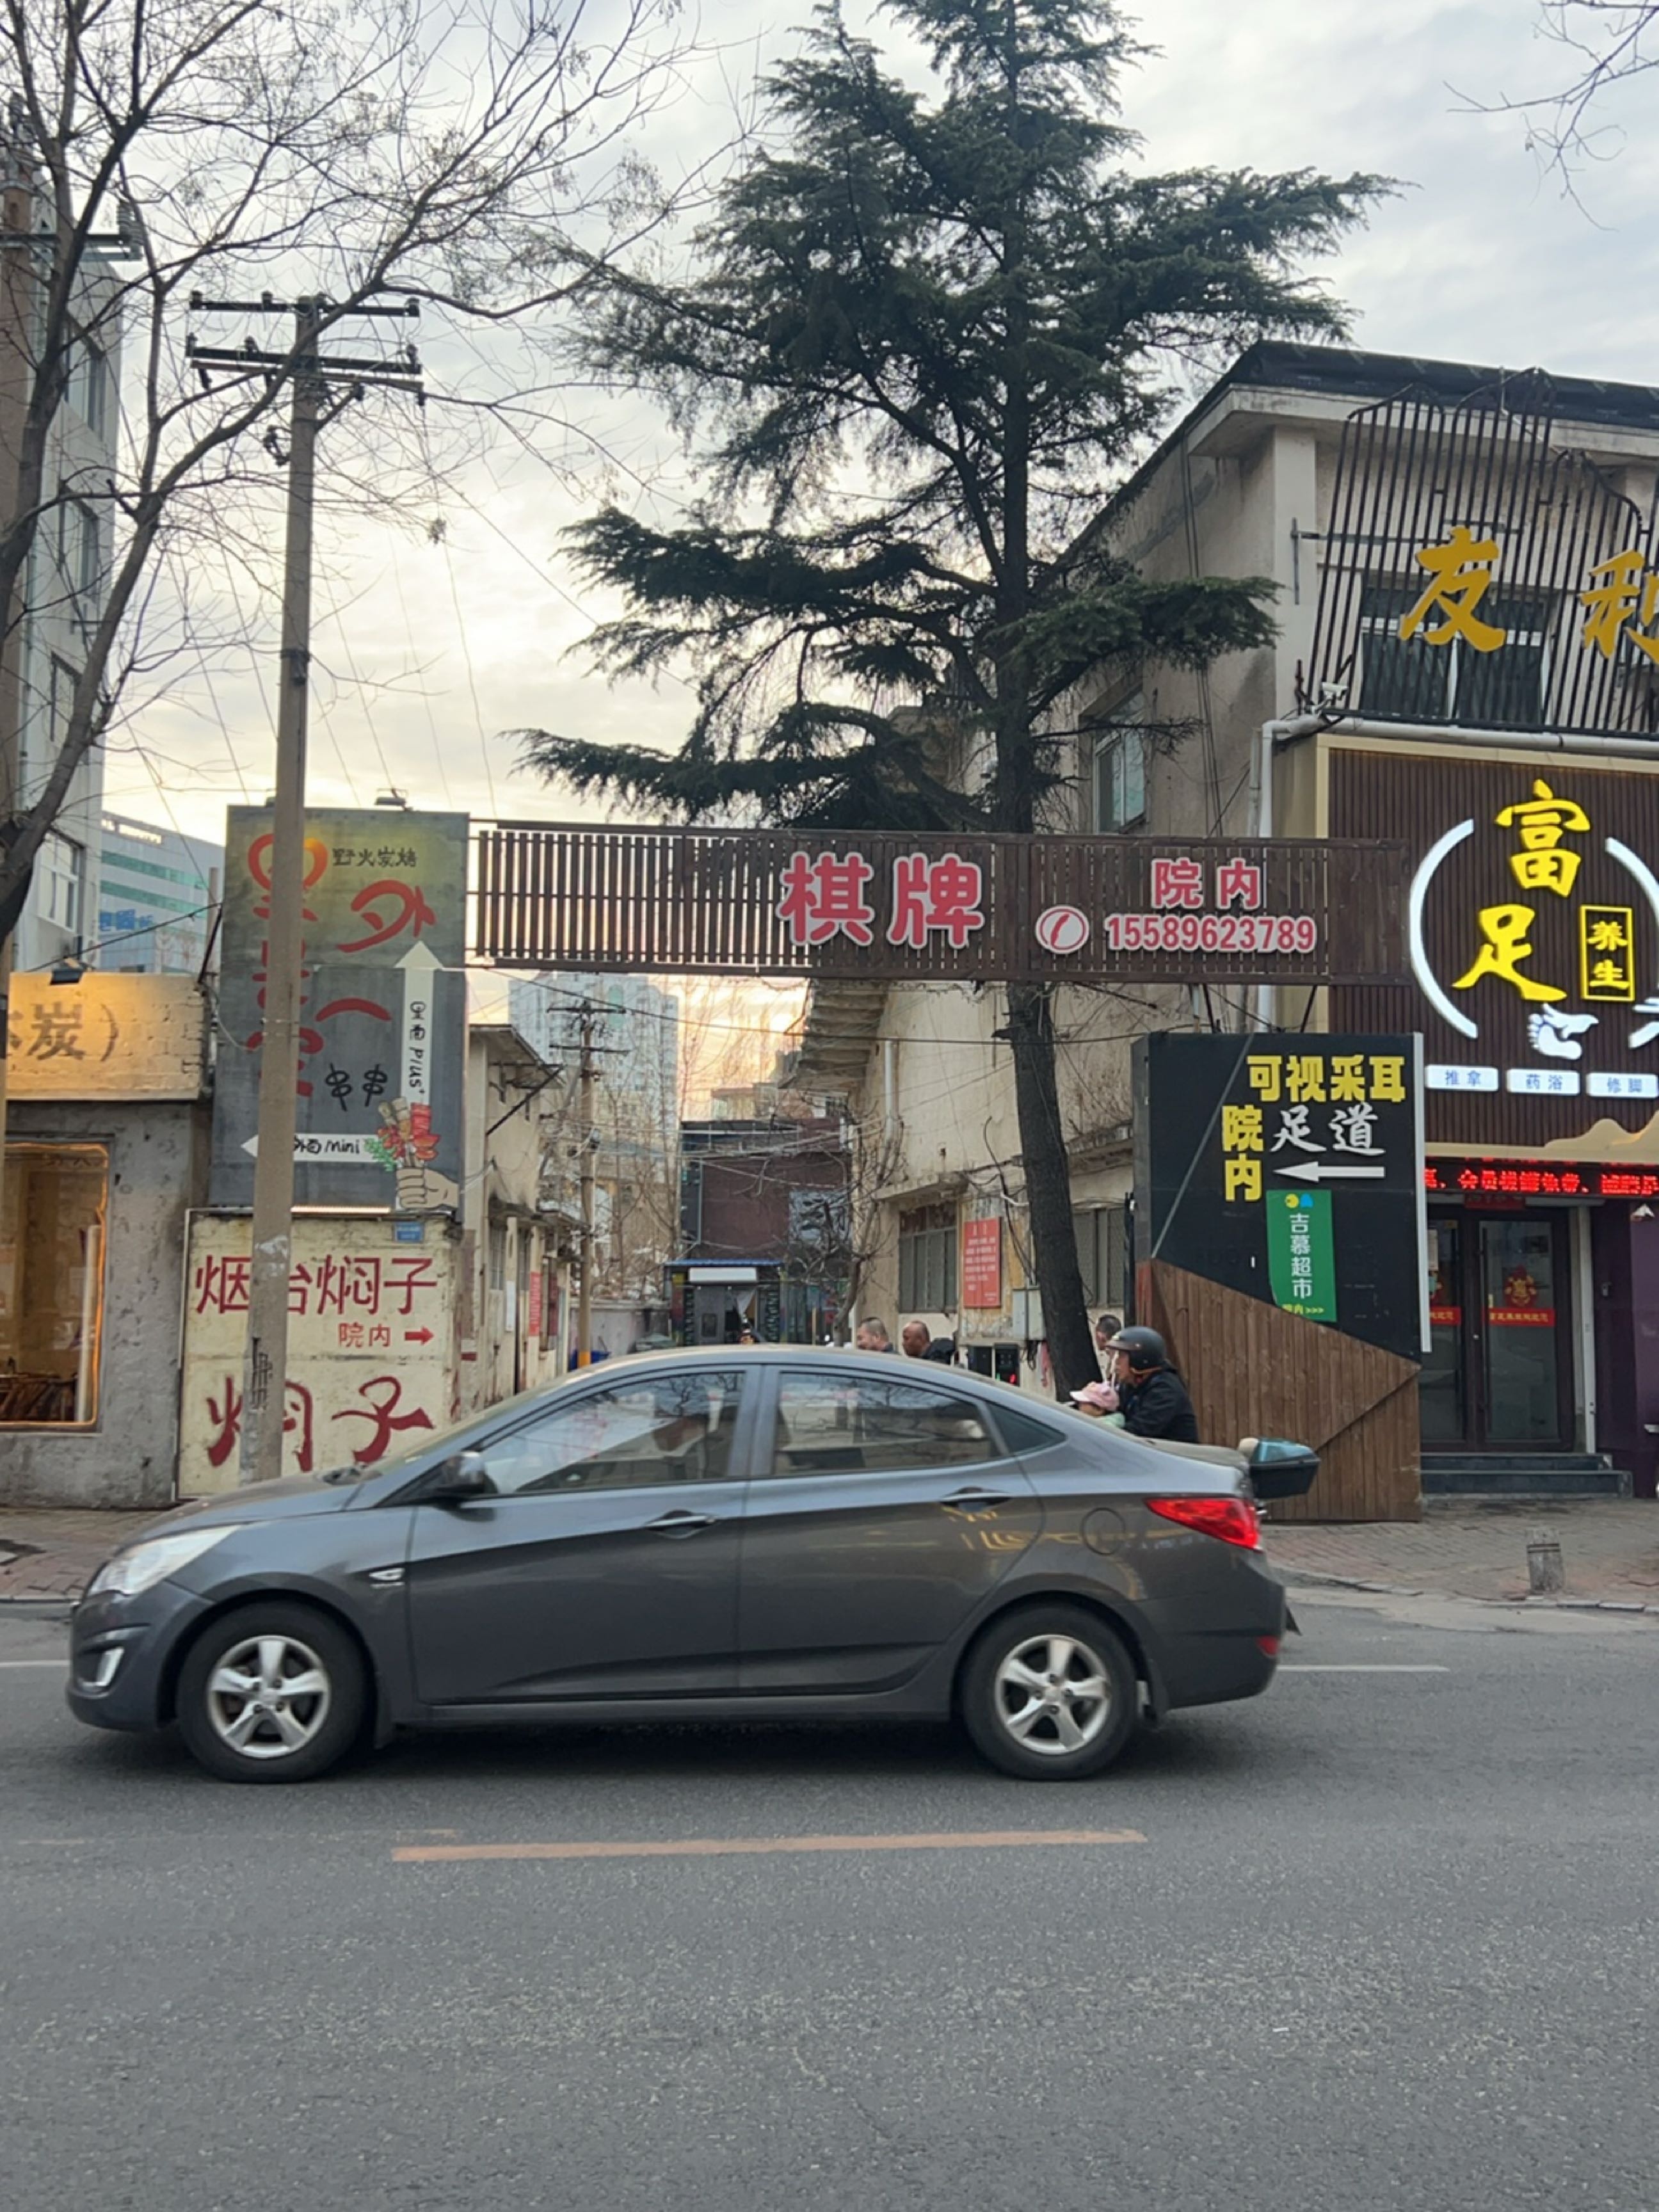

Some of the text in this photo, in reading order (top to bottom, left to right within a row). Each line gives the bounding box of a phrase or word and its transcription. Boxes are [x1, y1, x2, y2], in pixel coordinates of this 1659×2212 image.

[780, 851, 986, 950] 棋牌
[1152, 858, 1261, 909] 院内
[1452, 779, 1591, 1002] 富足
[1104, 915, 1316, 953] 15589623789
[1588, 920, 1630, 990] 养生
[1247, 1055, 1406, 1102] 可视采耳
[1445, 1070, 1482, 1087] 推拿
[1526, 1073, 1563, 1091] 药浴
[1221, 1104, 1265, 1202] 院内
[1270, 1103, 1386, 1156] 足道
[338, 1322, 390, 1348] 院内
